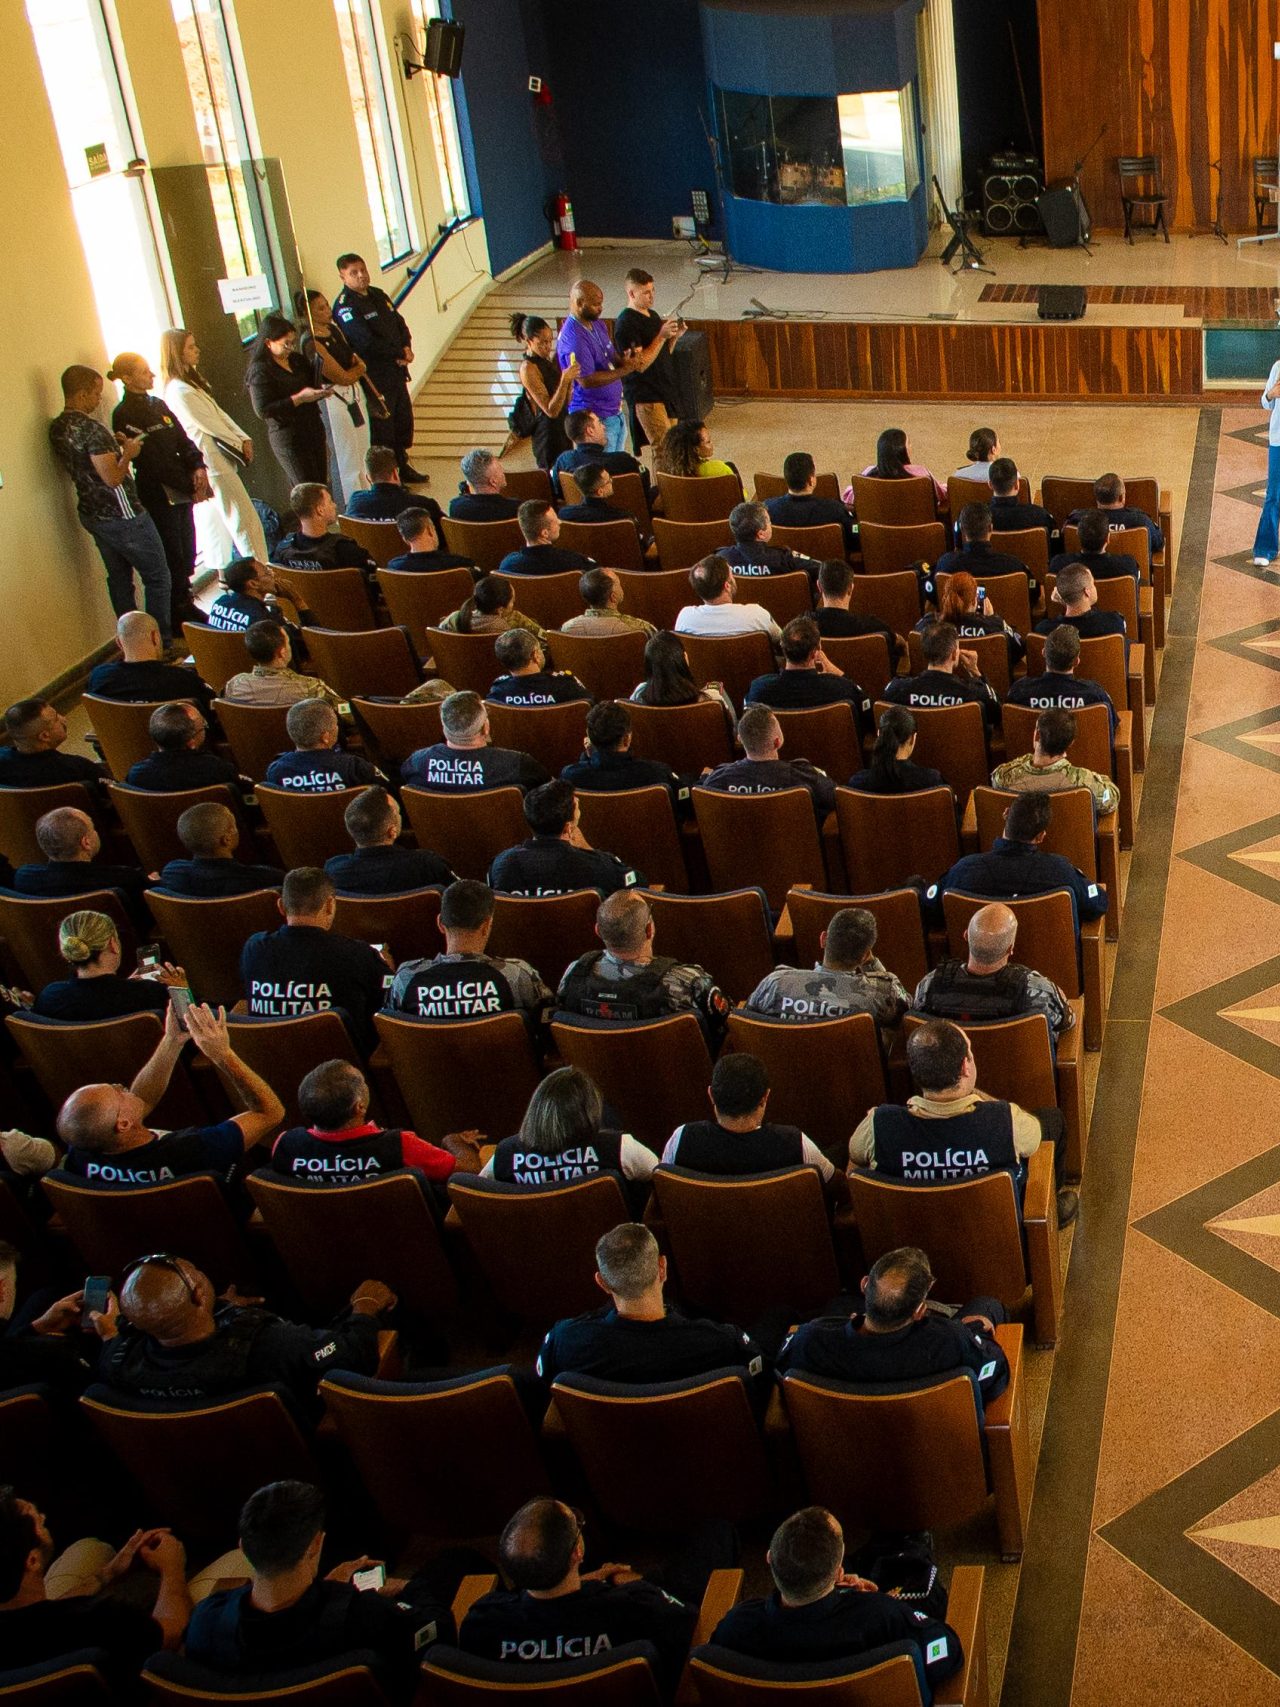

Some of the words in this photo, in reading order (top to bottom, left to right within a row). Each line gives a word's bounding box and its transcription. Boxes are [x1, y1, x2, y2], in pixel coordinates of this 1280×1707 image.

[212, 603, 250, 626] POLÍCIA
[505, 692, 556, 705] POLÍCIA
[910, 693, 963, 707] POLÍCIA
[1030, 695, 1085, 709] POLÍCIA
[428, 759, 484, 773] POLÍCIA
[282, 770, 343, 788] POLÍCIA
[427, 771, 485, 785] MILITAR
[251, 980, 332, 999] POLÍCIA
[417, 980, 498, 1001] POLÍCIA
[417, 997, 502, 1017] MILITAR
[292, 1154, 381, 1172] POLÍCIA
[902, 1148, 989, 1167] POLÍCIA
[87, 1162, 175, 1184] POLÍCIA
[314, 1341, 337, 1362] PMDF
[500, 1633, 613, 1660] POLÍCIA
